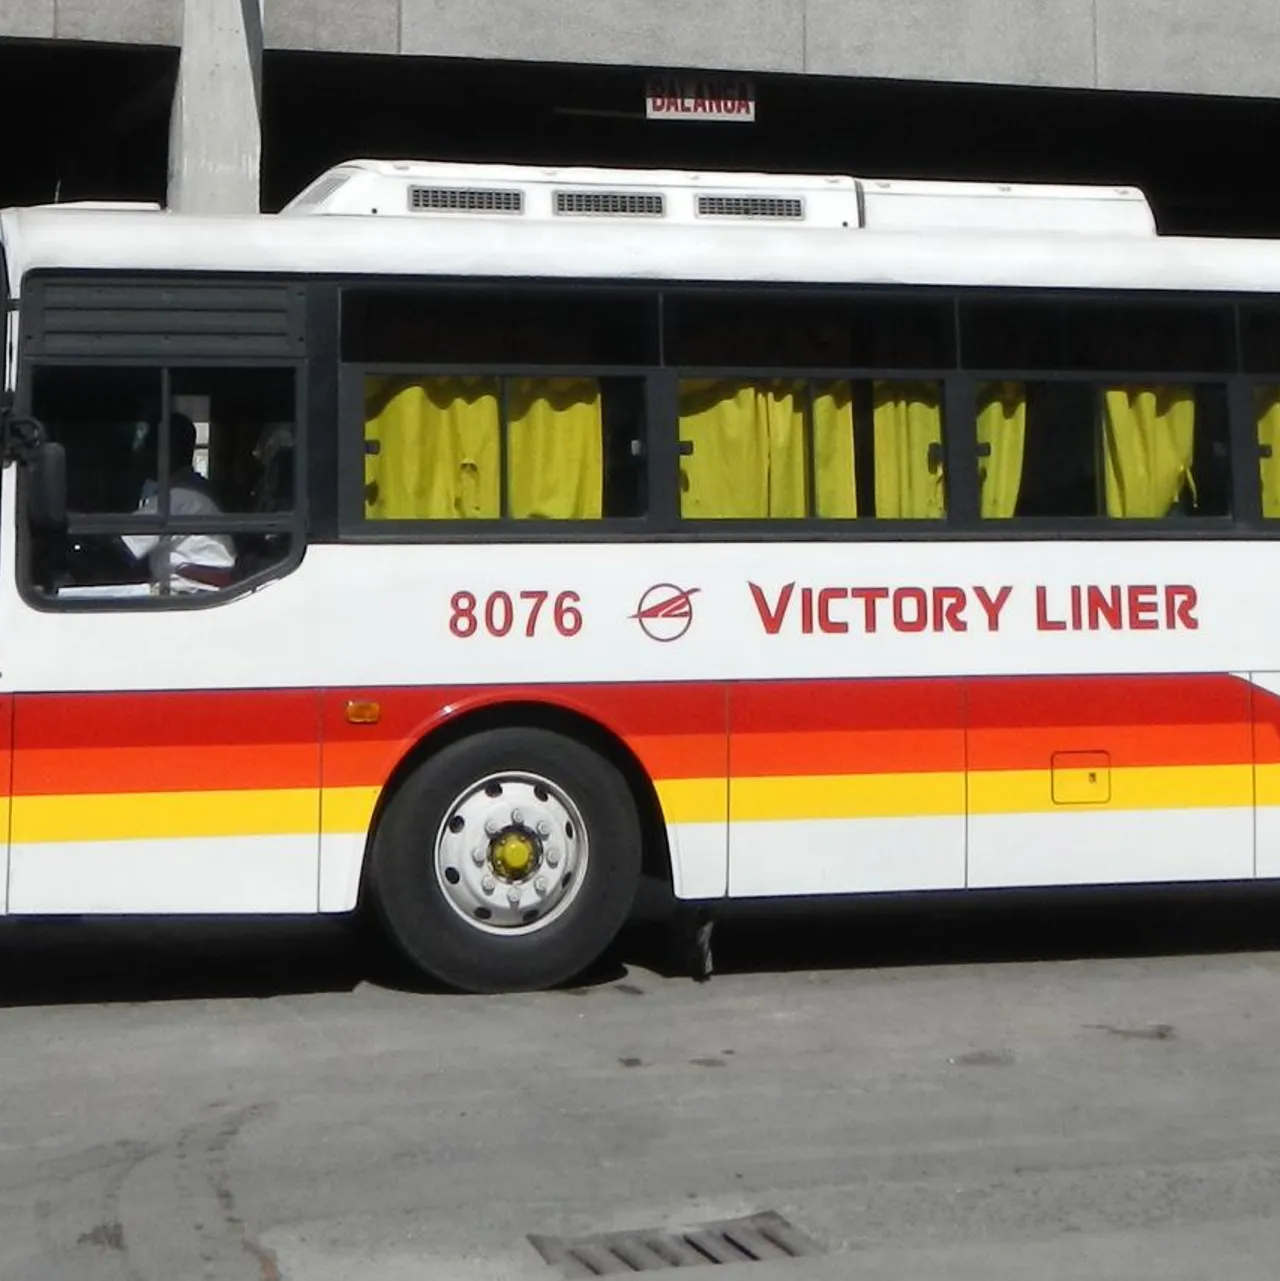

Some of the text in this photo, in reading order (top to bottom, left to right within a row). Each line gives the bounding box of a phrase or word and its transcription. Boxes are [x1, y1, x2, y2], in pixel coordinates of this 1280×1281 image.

[448, 590, 583, 638] 8076
[747, 581, 1200, 635] VICTORY LINER
